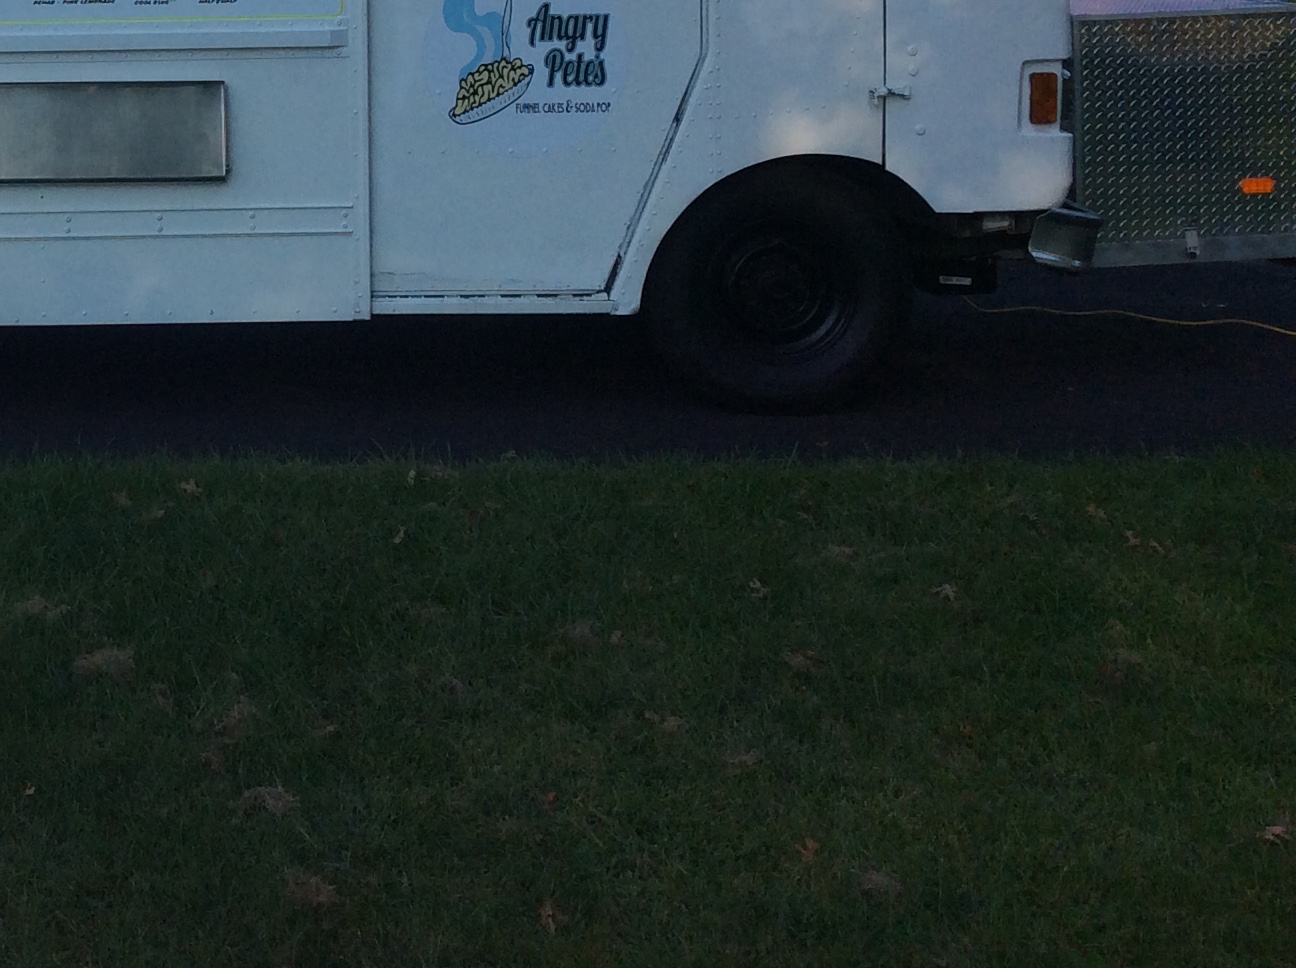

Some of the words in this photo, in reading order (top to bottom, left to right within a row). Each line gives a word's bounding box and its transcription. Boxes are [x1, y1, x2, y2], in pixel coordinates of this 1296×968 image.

[526, 1, 611, 53] Angry
[544, 47, 607, 88] Pete's
[515, 103, 541, 114] FUNNEL
[543, 103, 565, 113] CAKES
[575, 103, 596, 113] SODA
[597, 103, 611, 113] POP
